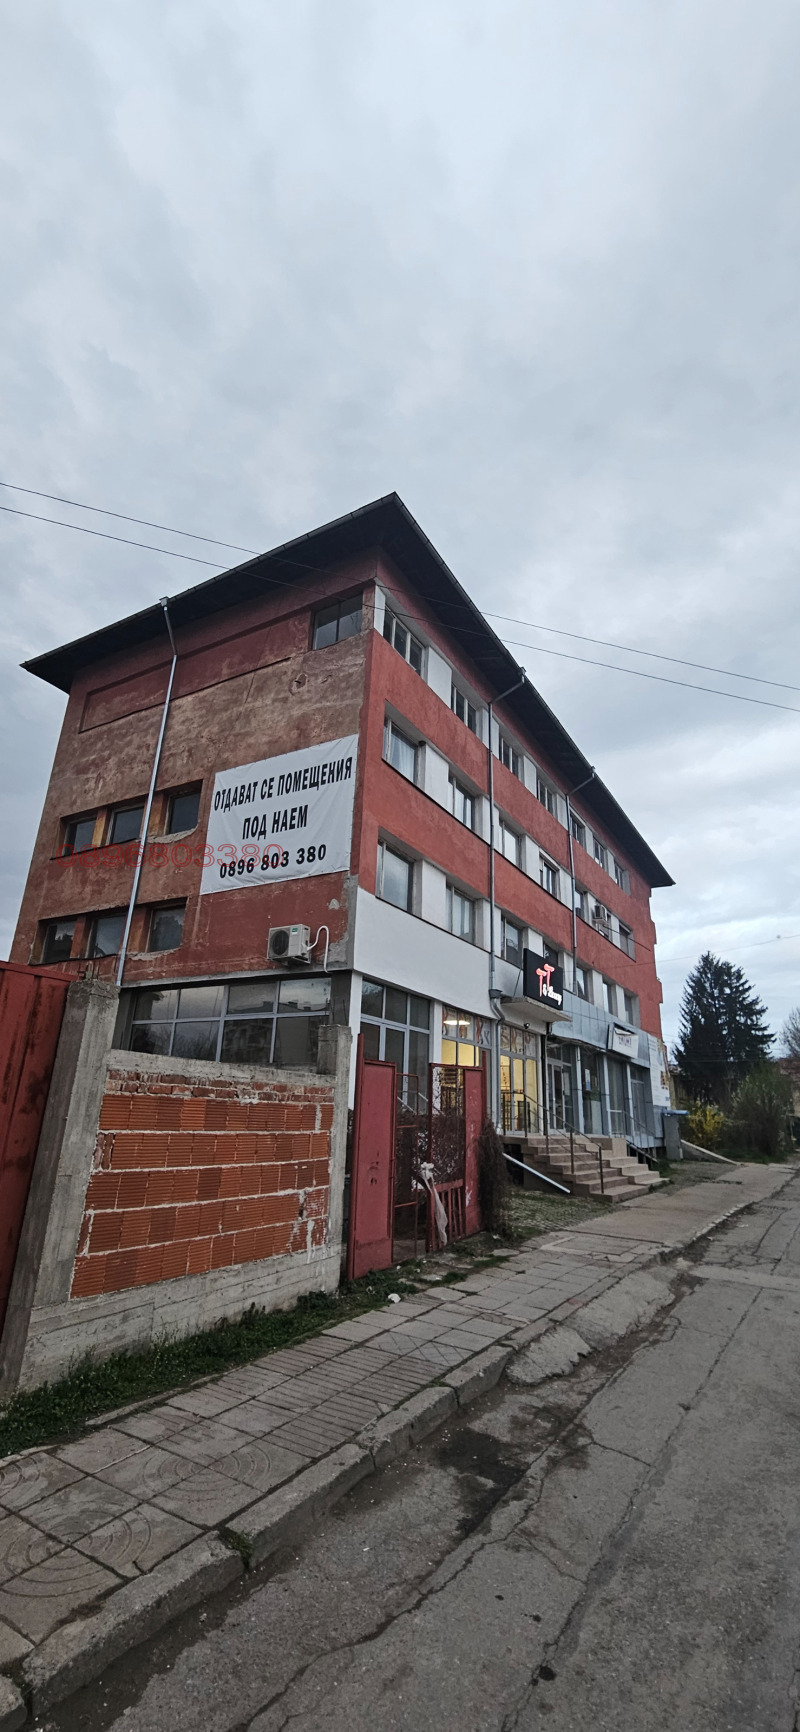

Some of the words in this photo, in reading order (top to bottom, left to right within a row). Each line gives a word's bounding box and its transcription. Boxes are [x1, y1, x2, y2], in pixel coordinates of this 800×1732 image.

[214, 781, 258, 812] ОТДАВАТ
[260, 777, 275, 800] СЕ
[277, 757, 353, 796] ПОМЕЩЕНИЯ
[242, 814, 267, 840] ПОД
[271, 805, 308, 833] НАЕМ
[219, 858, 254, 878] 0896
[260, 851, 289, 870] 803
[296, 844, 326, 864] 380
